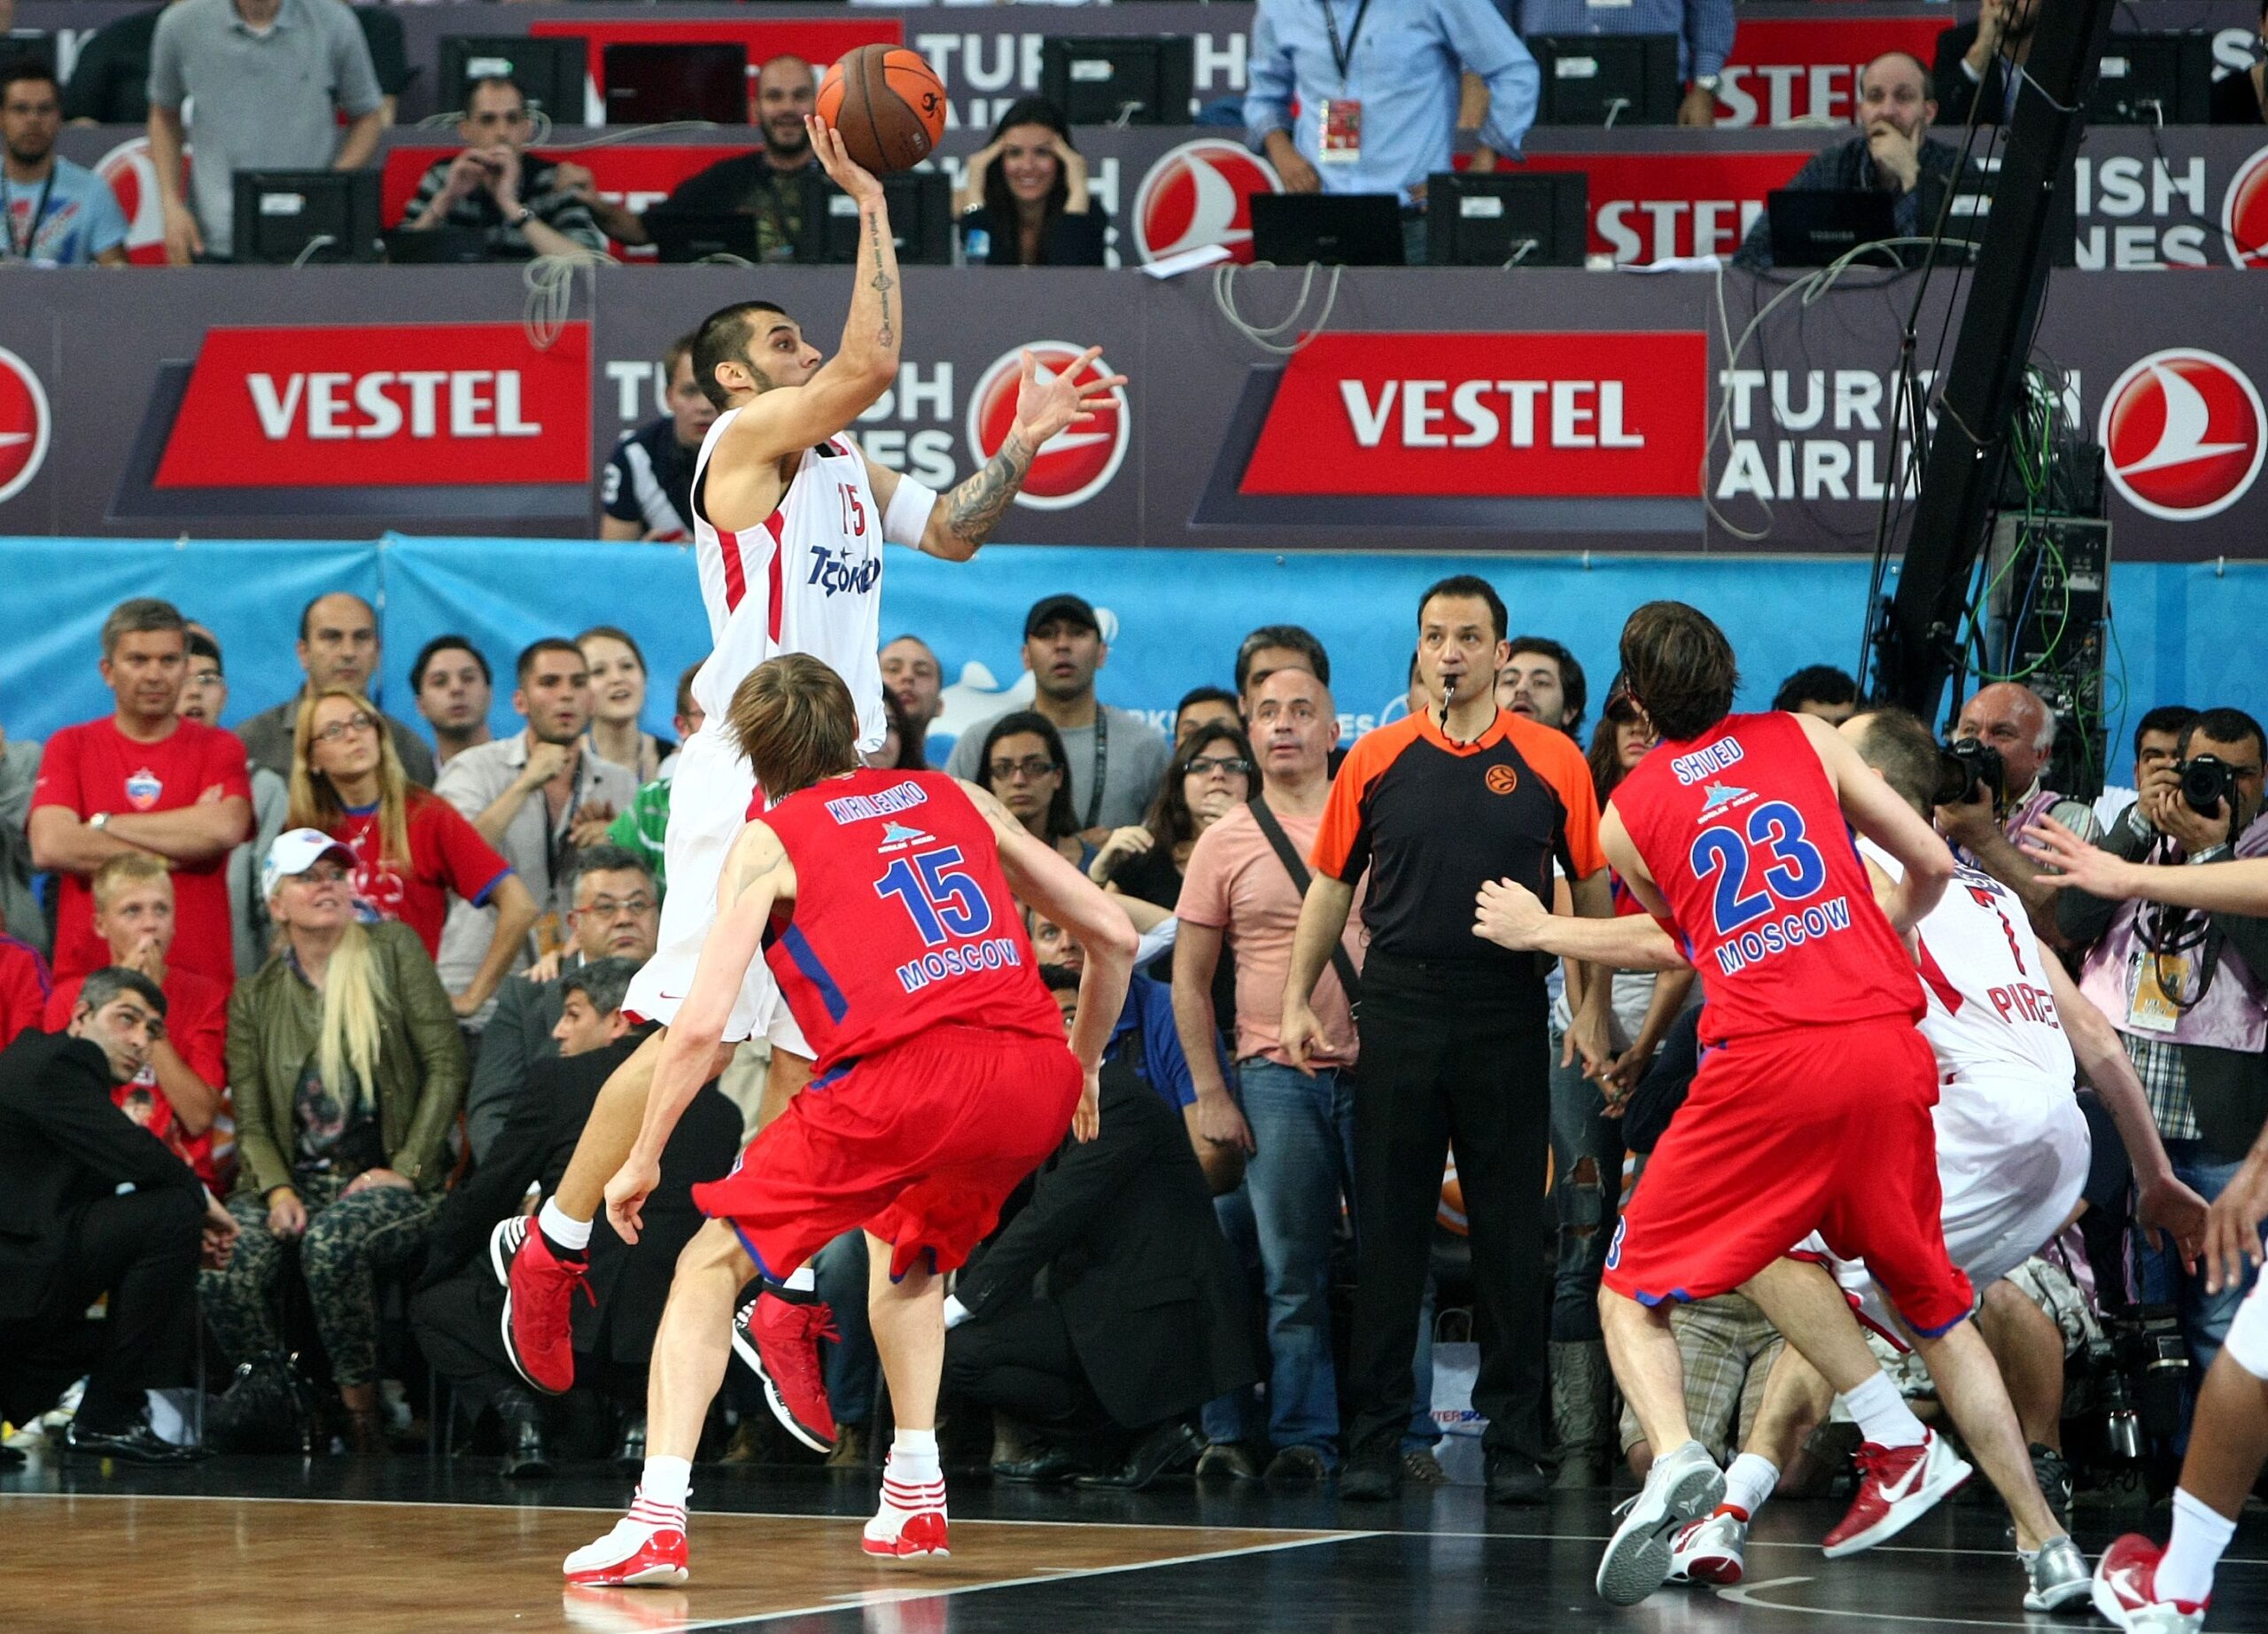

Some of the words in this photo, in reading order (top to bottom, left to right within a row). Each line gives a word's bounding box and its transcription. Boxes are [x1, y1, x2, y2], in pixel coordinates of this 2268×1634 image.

[246, 370, 542, 440] VESTEL
[1340, 379, 1645, 448] VESTEL
[837, 482, 866, 536] 15
[1671, 736, 1744, 786] SHVED
[825, 781, 928, 825] KIRILENKO
[873, 844, 992, 947] 15
[1689, 800, 1827, 937] 23
[896, 938, 1021, 994] MOSCOW
[1715, 896, 1852, 977] MOSCOW
